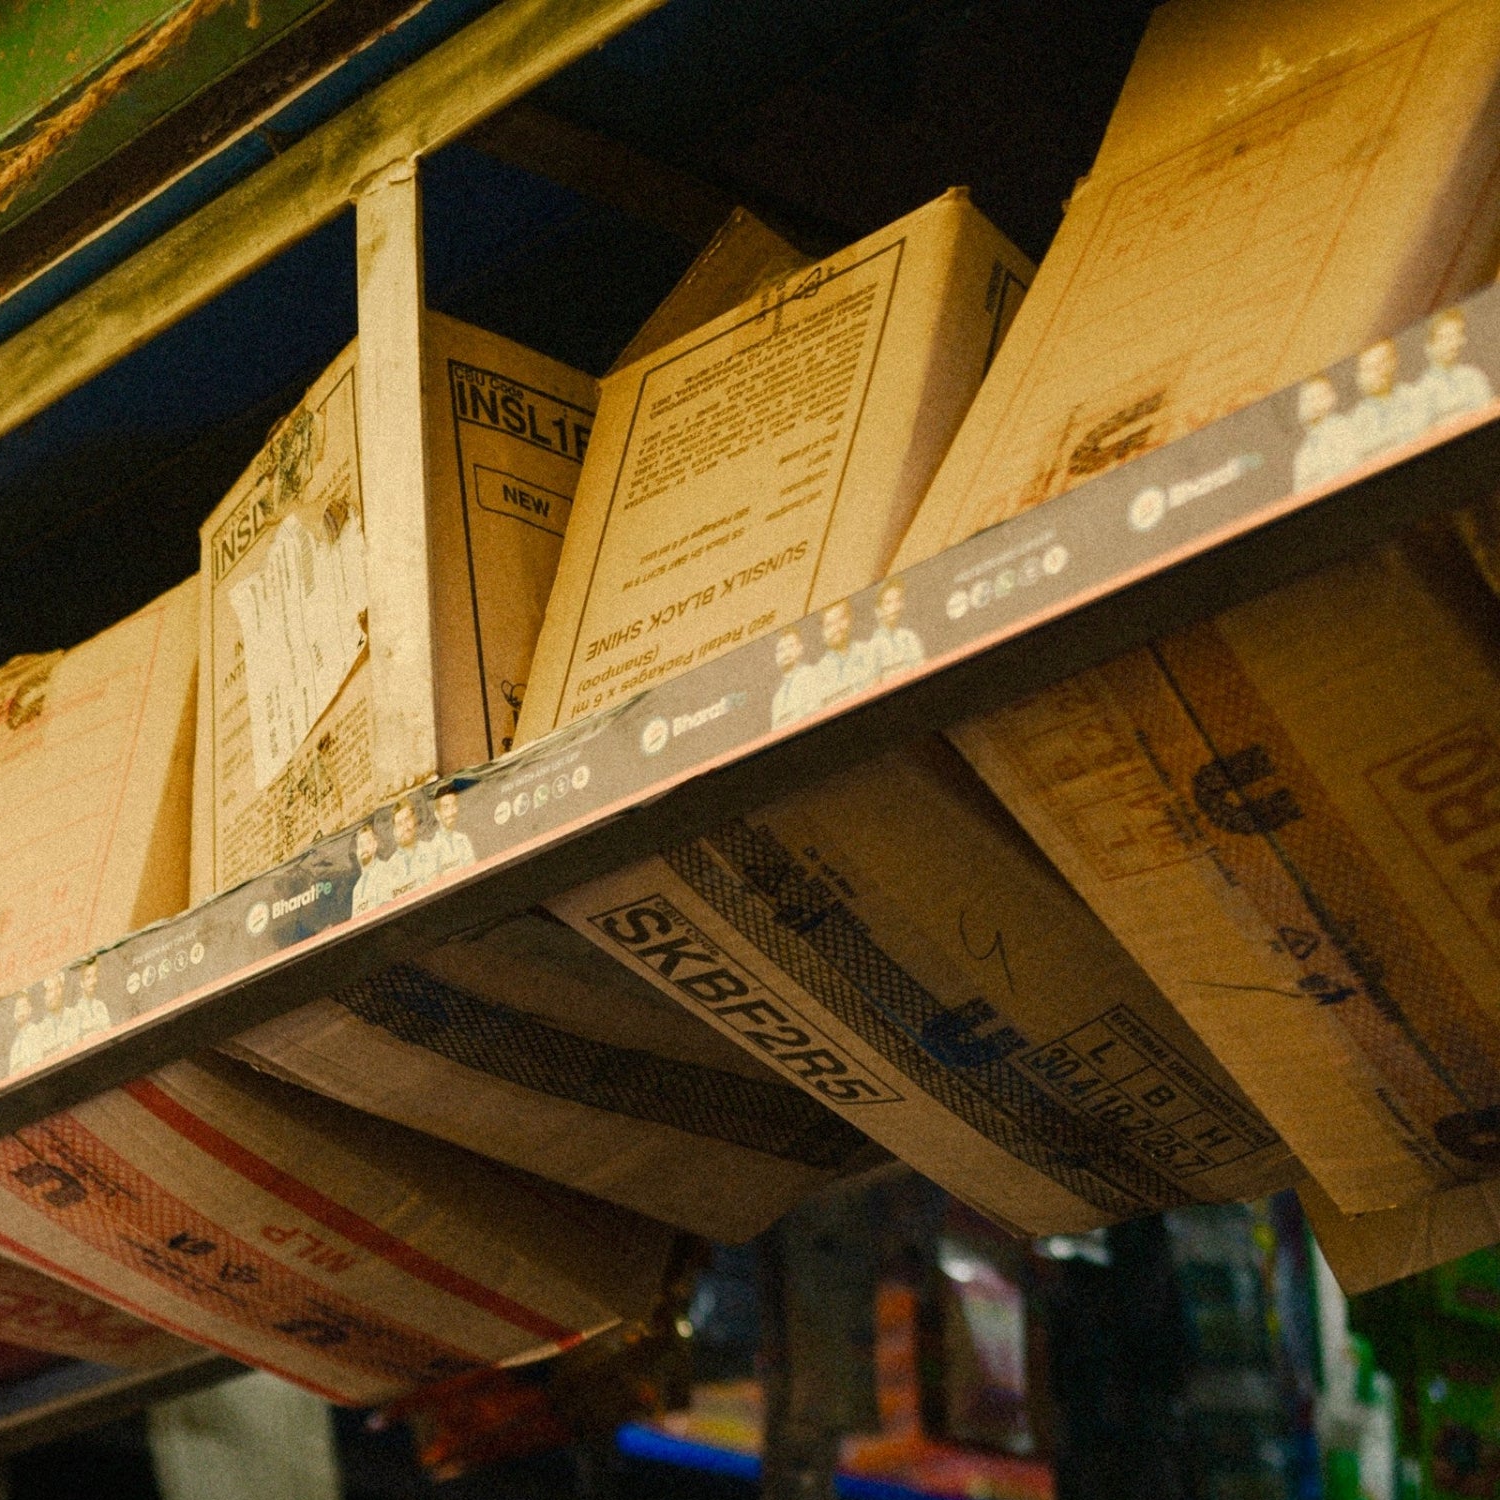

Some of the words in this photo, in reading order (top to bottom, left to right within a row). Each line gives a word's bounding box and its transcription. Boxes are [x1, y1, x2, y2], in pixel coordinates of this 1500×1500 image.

[502, 484, 550, 518] NEW
[718, 538, 809, 599] SUNSILK
[646, 582, 717, 633] BLACK
[583, 617, 644, 663] SHINE
[697, 623, 745, 659] Retail
[575, 642, 660, 697] (Shampoo)
[619, 645, 696, 694] Packages
[570, 698, 590, 717] ml
[271, 880, 333, 920] BharatPe
[601, 905, 882, 1102] SKBF2R5
[1032, 1047, 1101, 1097] 30.4
[1088, 1094, 1155, 1138] 18.2
[1141, 1134, 1210, 1169] 25.7
[1089, 1039, 1117, 1065] L
[1141, 1085, 1177, 1108] B
[1194, 1125, 1232, 1147] H
[261, 1222, 361, 1275] MLP
